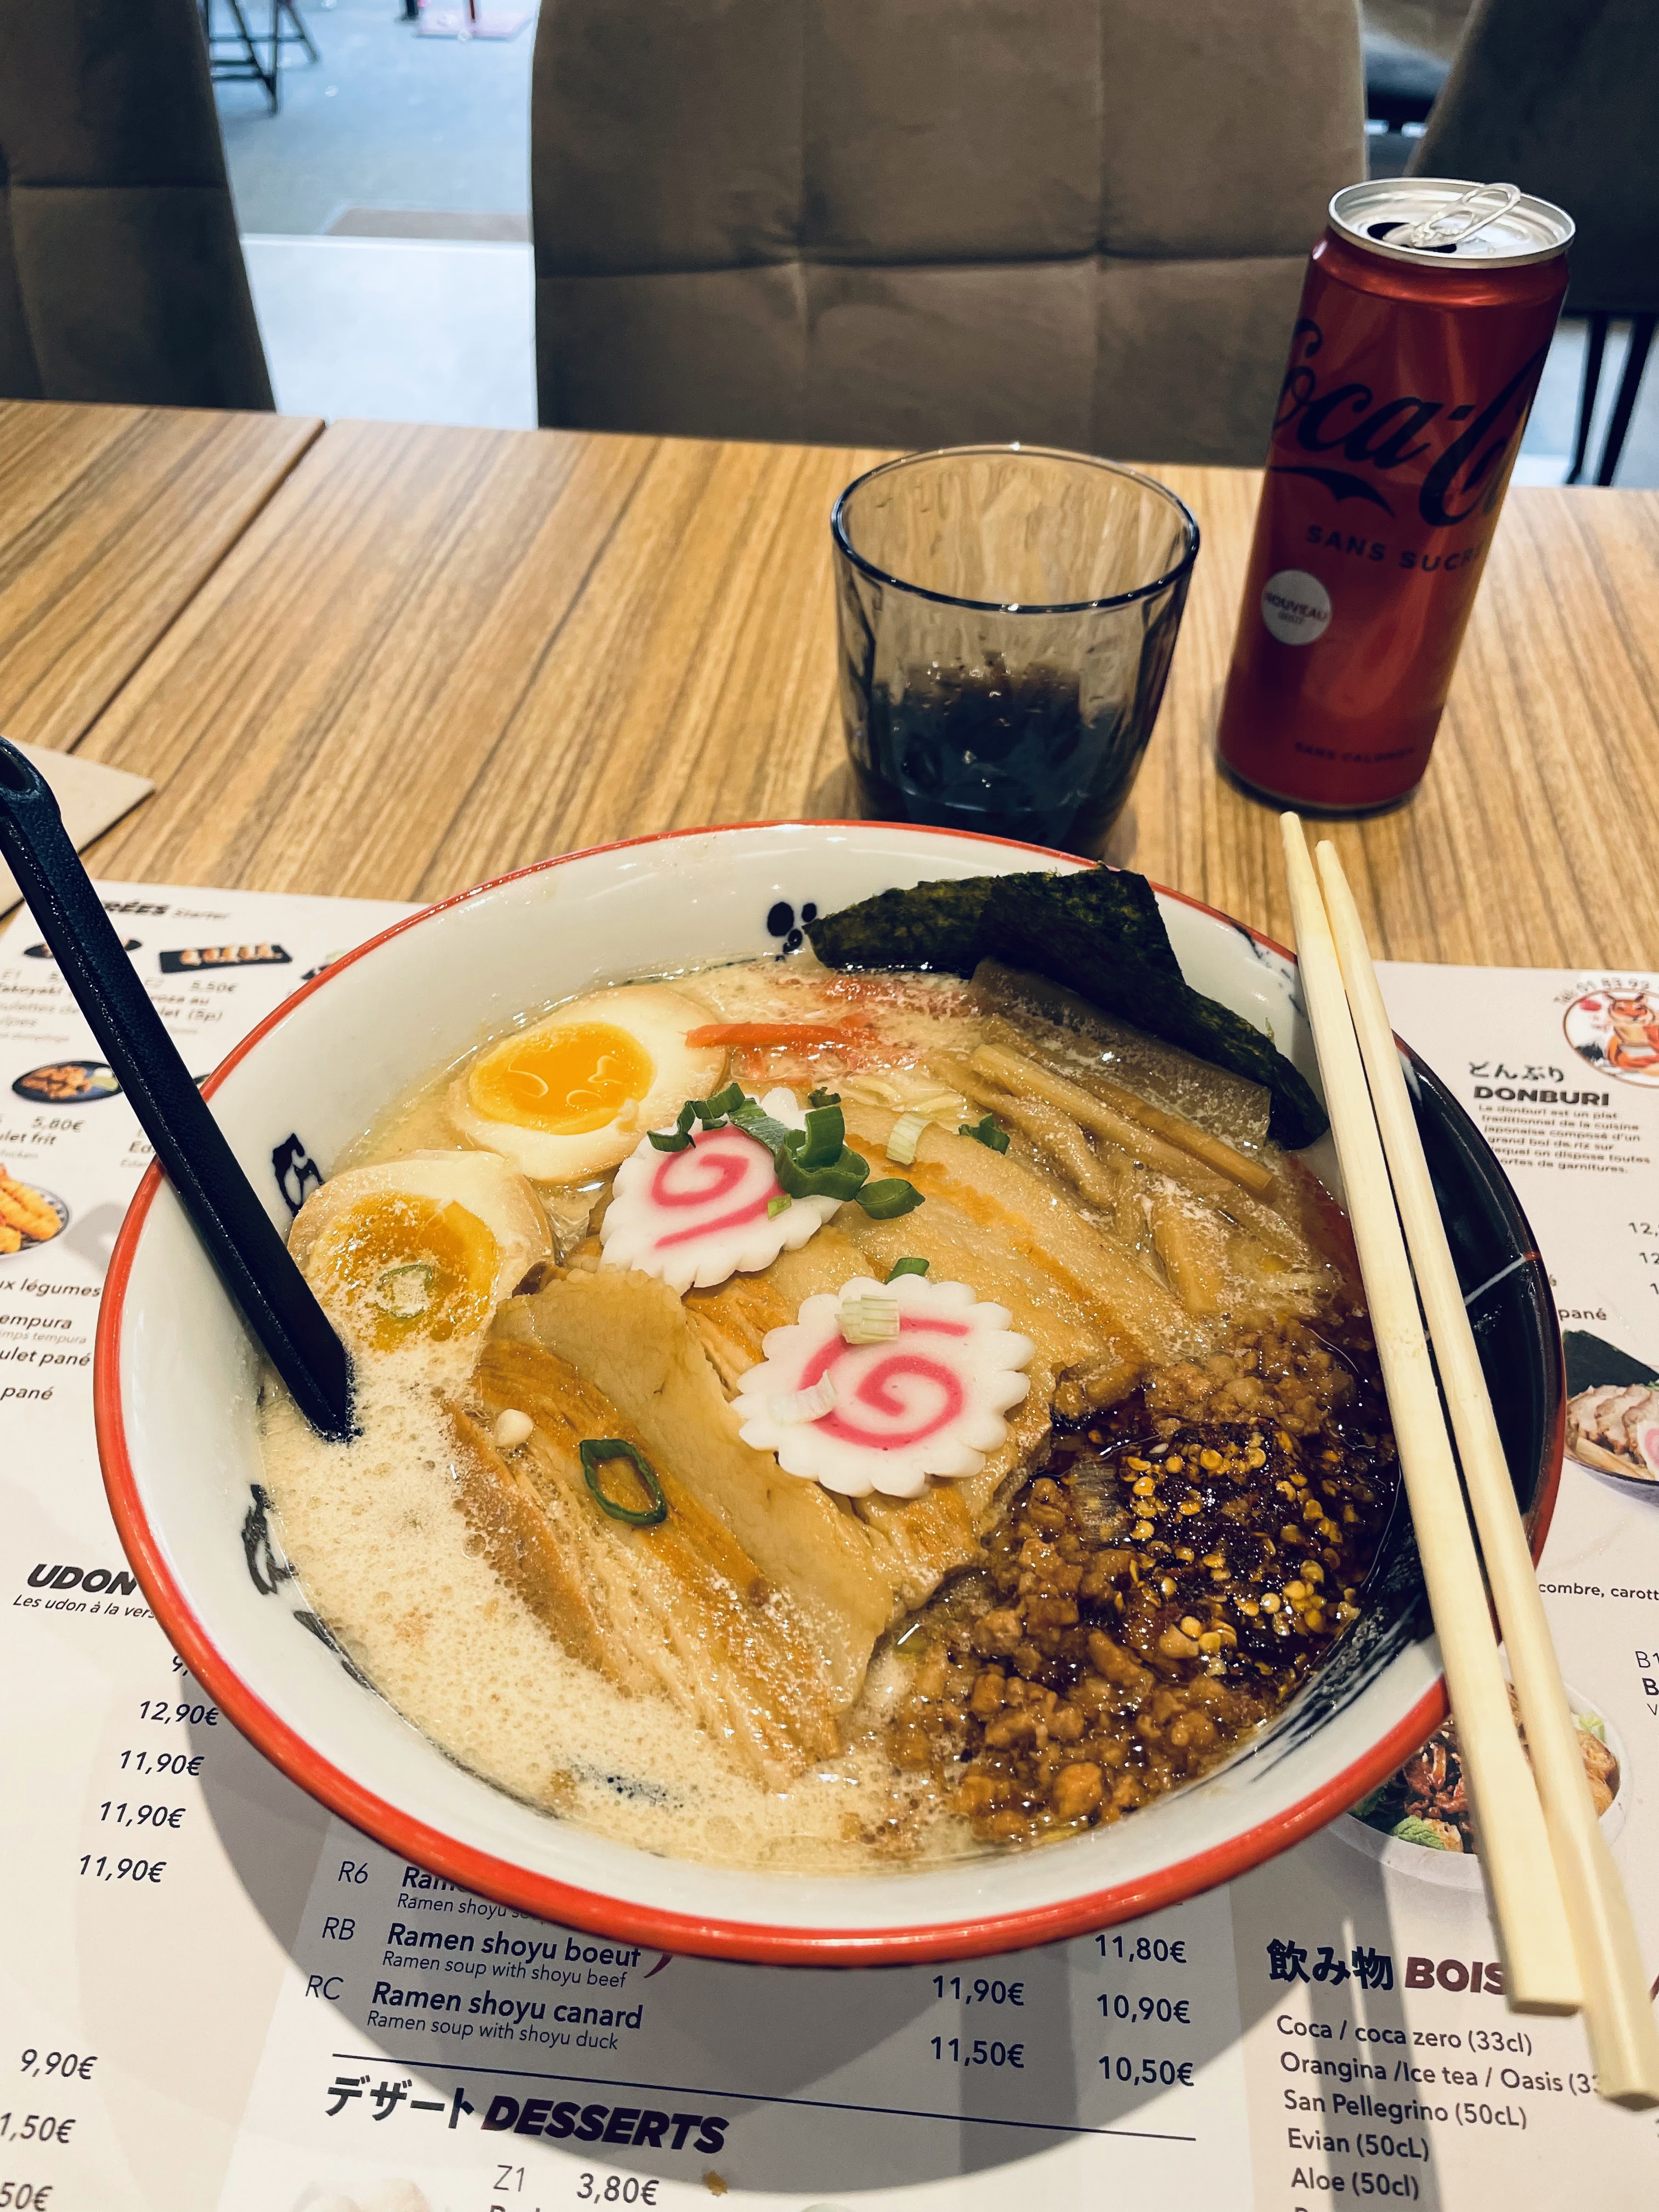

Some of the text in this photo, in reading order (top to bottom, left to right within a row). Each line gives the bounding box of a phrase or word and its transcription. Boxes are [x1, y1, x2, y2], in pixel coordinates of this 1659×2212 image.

[1307, 524, 1486, 572] SANS SUCR
[1474, 1086, 1610, 1106] DONBURI
[1482, 1114, 1555, 1126] traditionnel
[1497, 1105, 1546, 1115] donburi
[1593, 1111, 1617, 1120] plat
[31, 1131, 57, 1146] frit
[1485, 1125, 1545, 1136] japonaise
[1488, 1136, 1525, 1146] grand
[1529, 1138, 1549, 1147] bol
[1554, 1140, 1570, 1148] de
[1500, 1158, 1533, 1167] ortes
[1554, 1151, 1604, 1161] dispose
[1609, 1154, 1650, 1164] toutes
[1628, 1222, 1659, 1237] 12,
[20, 1277, 101, 1297] légumes
[0, 1314, 72, 1330] empura
[1558, 1307, 1607, 1321] pané
[32, 1331, 87, 1345] tempura
[0, 1347, 92, 1367] ulet pané
[1, 1385, 54, 1401] pané
[27, 1564, 138, 1595] UDON
[1538, 1583, 1659, 1601] combre, carott
[13, 1594, 156, 1619] Les udon à la vers
[139, 1701, 219, 1726] 12,90€
[120, 1750, 205, 1776] 11,90€
[100, 1801, 185, 1829] 11,90€
[80, 1854, 166, 1883] 11,90€
[338, 1861, 368, 1884] R6
[397, 1893, 454, 1912] Ramen
[458, 1898, 507, 1920] shoyu
[322, 1916, 356, 1941] RB
[387, 1922, 475, 1952] Ramen
[481, 1931, 557, 1964] shoyu
[1095, 1934, 1187, 1963] 11,80€
[382, 1950, 628, 1988] Ramen soup with shoyu beef
[1266, 1938, 1395, 1991] 飲み物
[1404, 1956, 1508, 1995] BOIS
[306, 1974, 643, 2029] RC Ramen shoyu canard
[933, 1975, 1191, 2024] 11,90€ 10,90€
[367, 2010, 618, 2050] Ramen soup with shoyu duck
[1277, 2015, 1532, 2056] Coca / coca zero (33cl)
[20, 2049, 98, 2080] 9,90€
[930, 2036, 1195, 2087] 11,50€ 10,50€
[1280, 2051, 1387, 2083] Orangina
[1442, 2066, 1478, 2086] tea
[1485, 2067, 1493, 2087] /
[1500, 2068, 1564, 2092] Oasis
[325, 2074, 475, 2129] デザート
[1284, 2089, 1527, 2130] San Pellegrino (50cL)
[0, 2112, 76, 2144] 1,50€
[480, 2095, 730, 2154] DESSERTS
[1288, 2127, 1429, 2162] Evian (50cL)
[0, 2181, 53, 2212] 50€
[493, 2164, 659, 2205] Z1 3,80€
[1291, 2166, 1419, 2202] Aloe (50cl)
